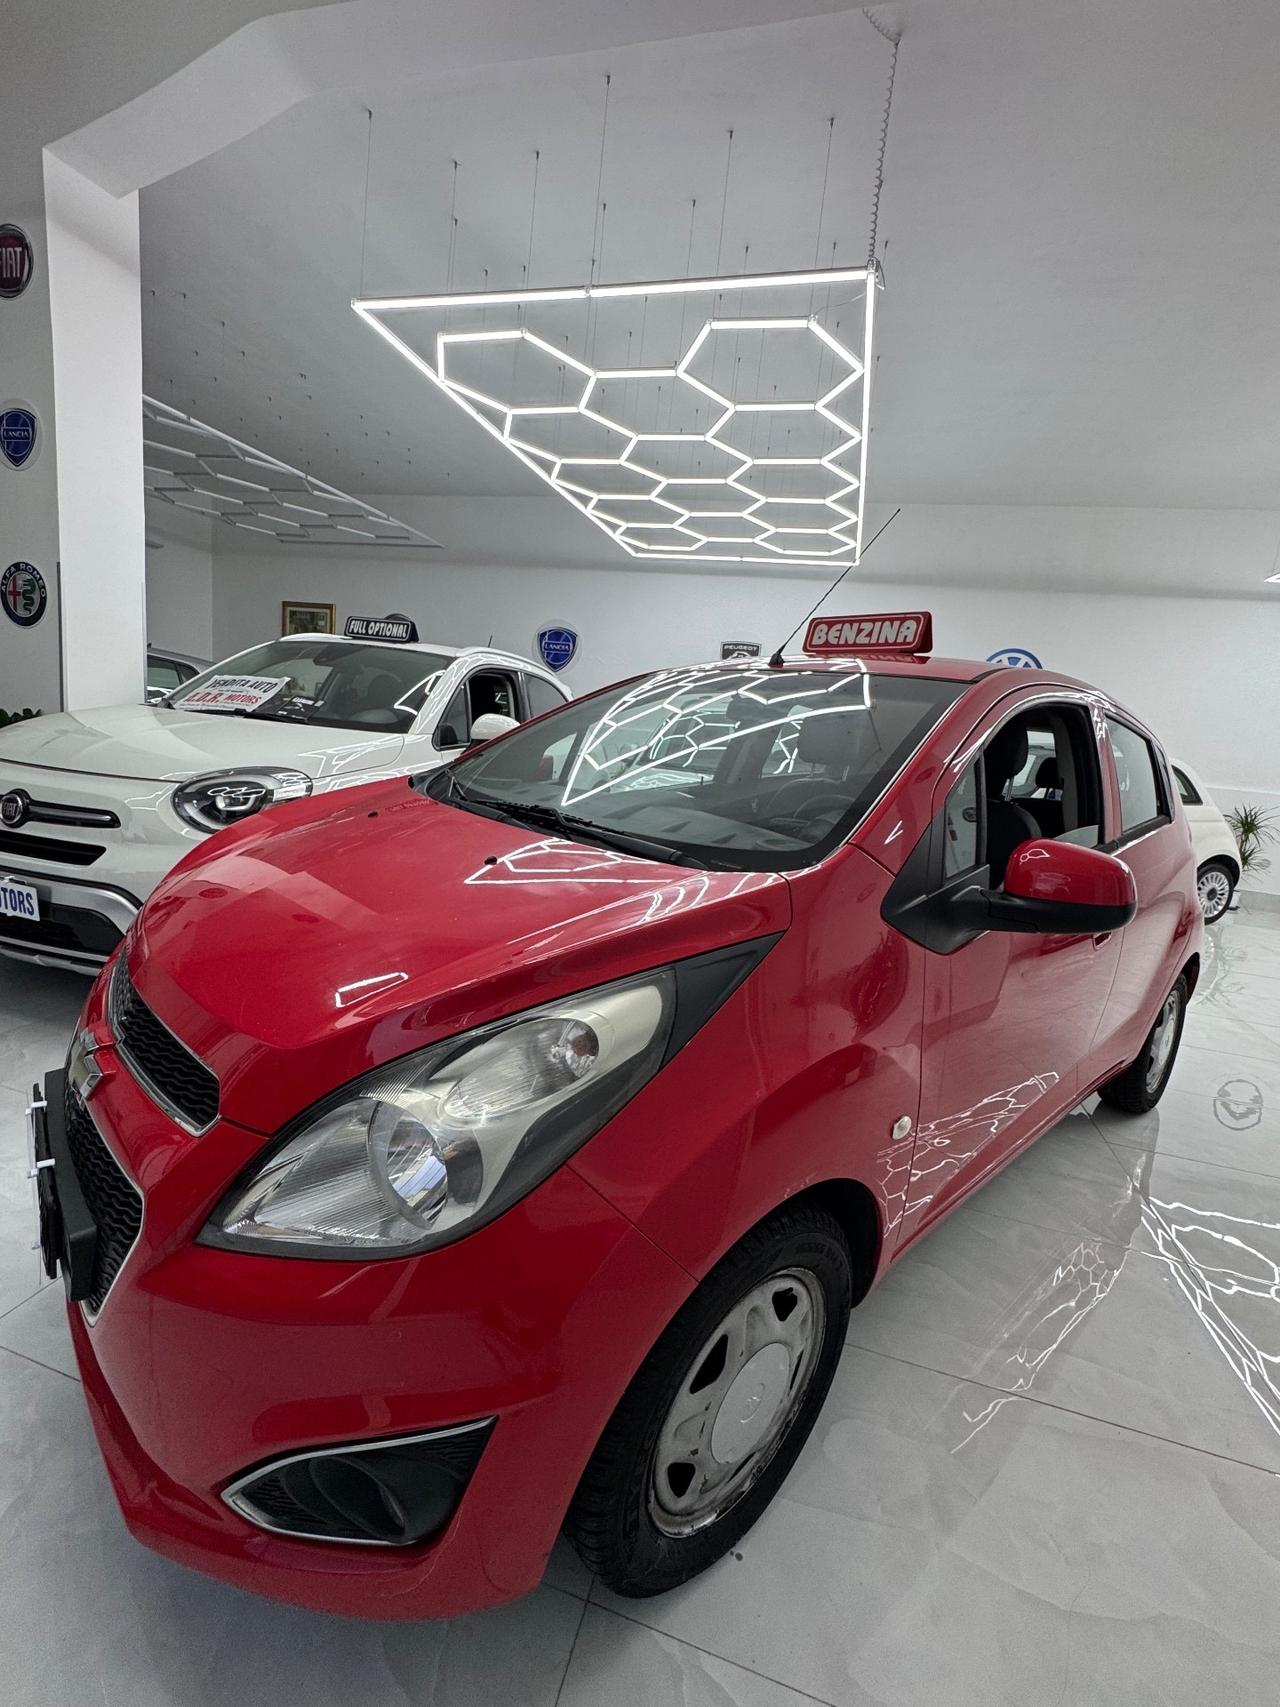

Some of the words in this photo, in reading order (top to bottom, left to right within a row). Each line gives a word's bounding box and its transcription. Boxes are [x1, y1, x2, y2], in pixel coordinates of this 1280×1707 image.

[0, 247, 22, 278] IAT
[3, 430, 29, 438] LANCIA
[2, 566, 17, 592] ALFA
[20, 563, 46, 597] ROMEO
[349, 620, 367, 634] FULL
[368, 622, 408, 638] OPTIONAL
[811, 619, 918, 646] BENZINA
[544, 643, 570, 651] LANCIA
[247, 680, 278, 693] AUTO
[223, 693, 262, 704] MOTORS
[0, 887, 34, 916] TORS
